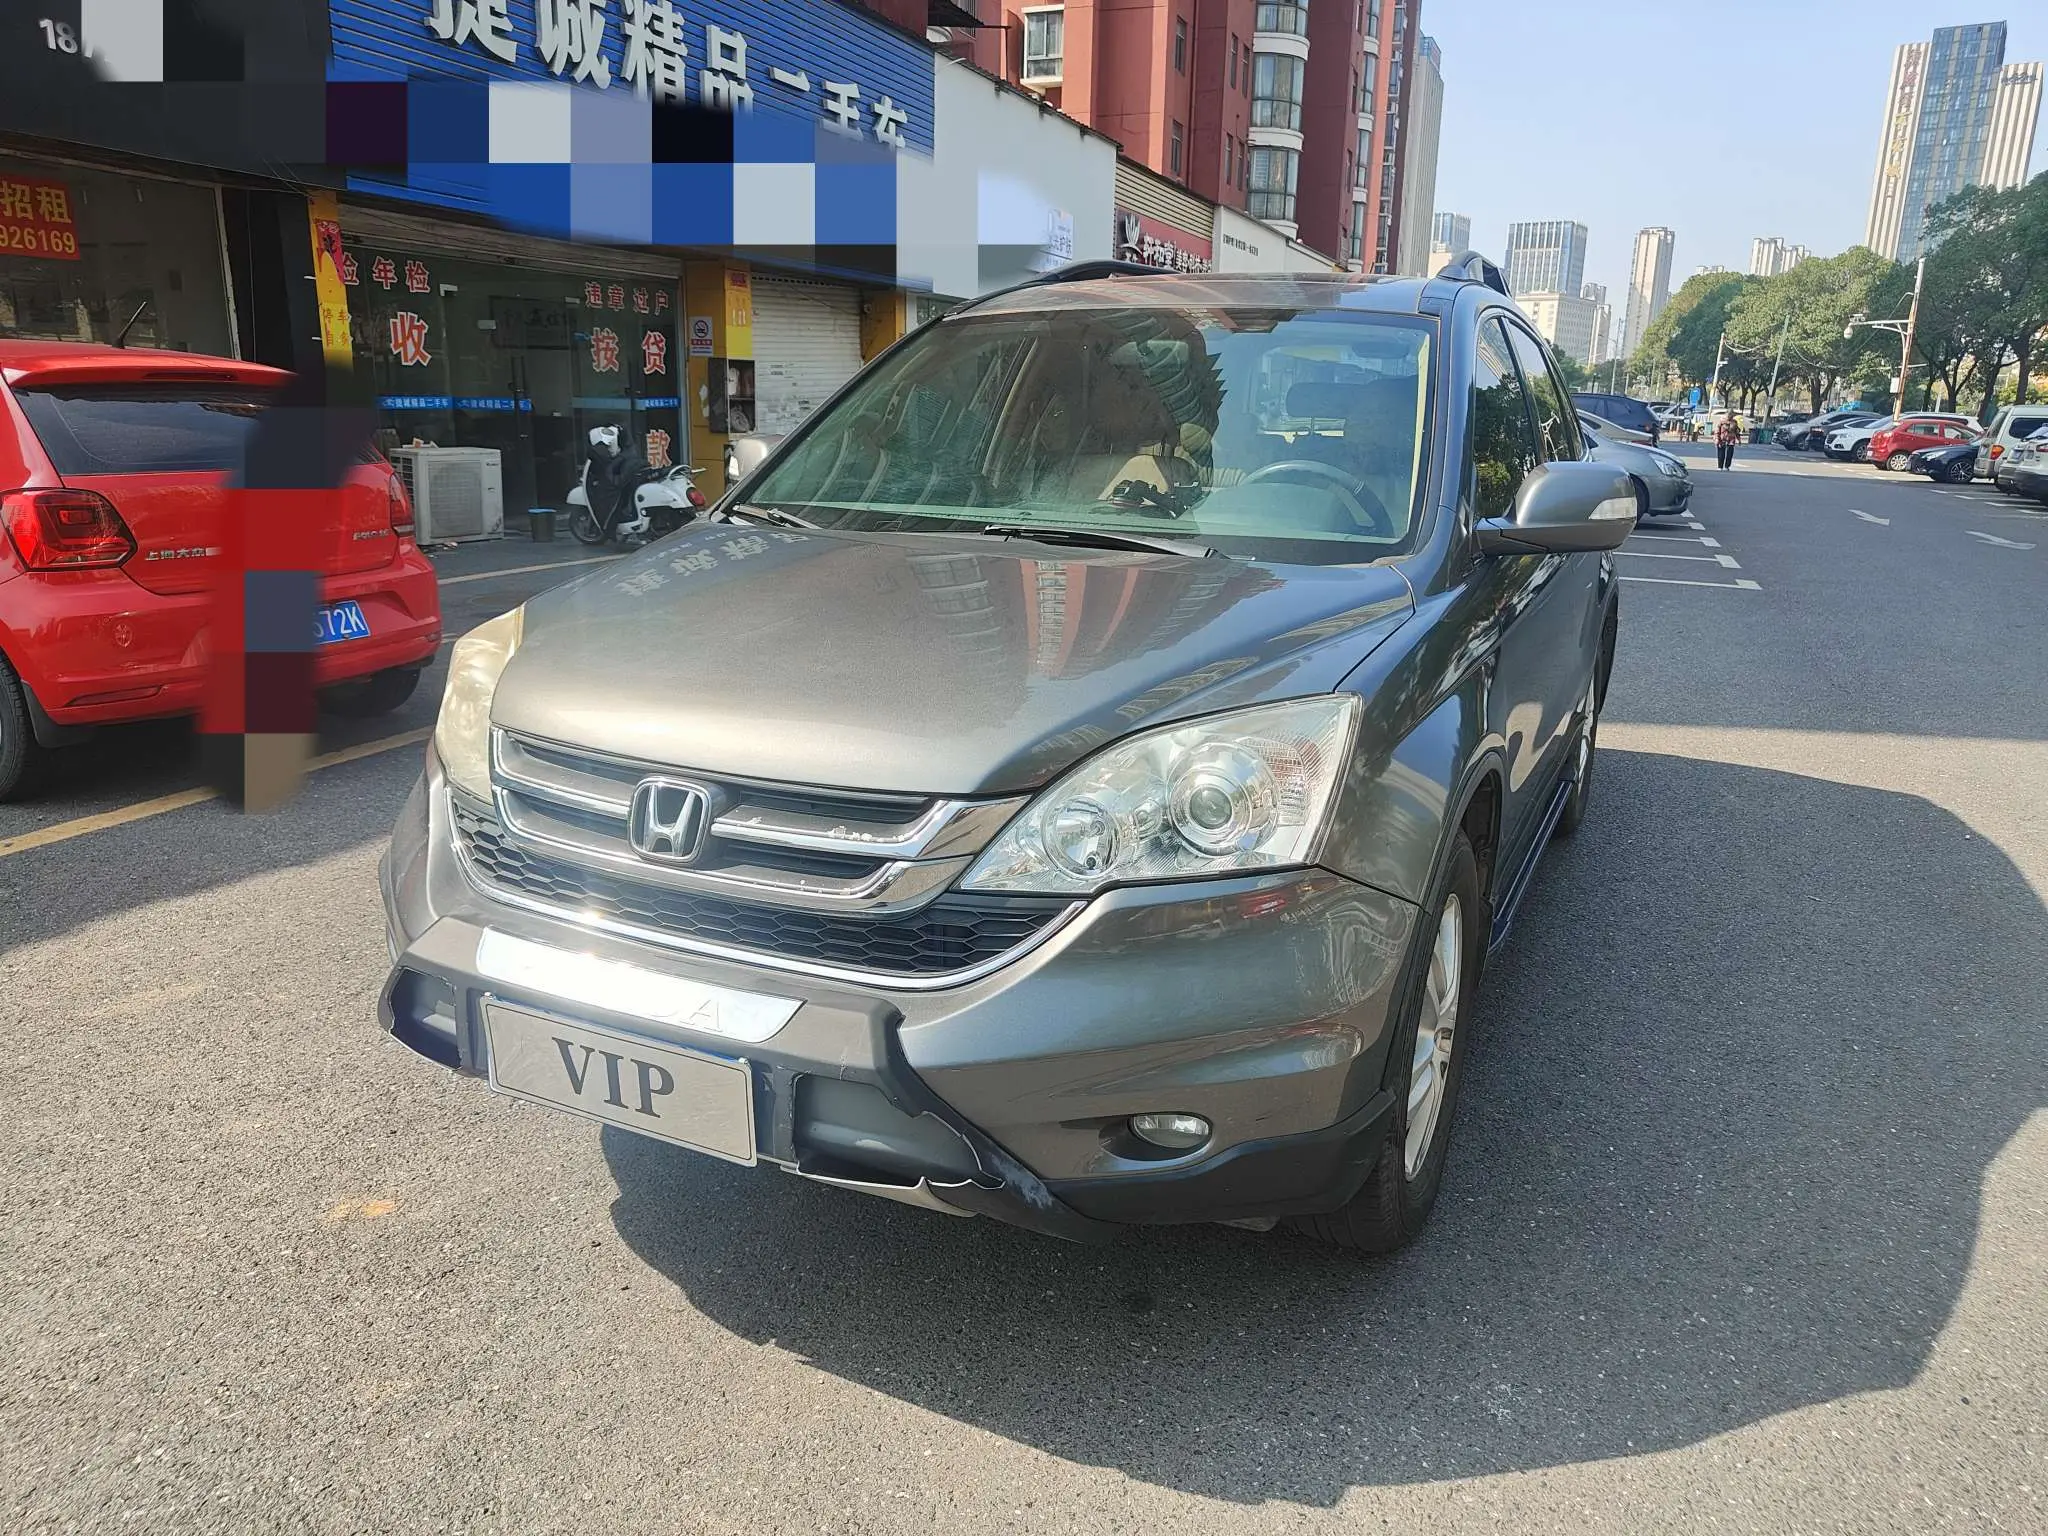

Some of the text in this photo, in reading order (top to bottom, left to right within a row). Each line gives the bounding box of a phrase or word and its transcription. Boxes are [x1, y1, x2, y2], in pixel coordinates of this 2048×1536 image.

[0, 180, 72, 223] 招租
[390, 312, 432, 366] 收
[551, 1036, 676, 1118] VIP
